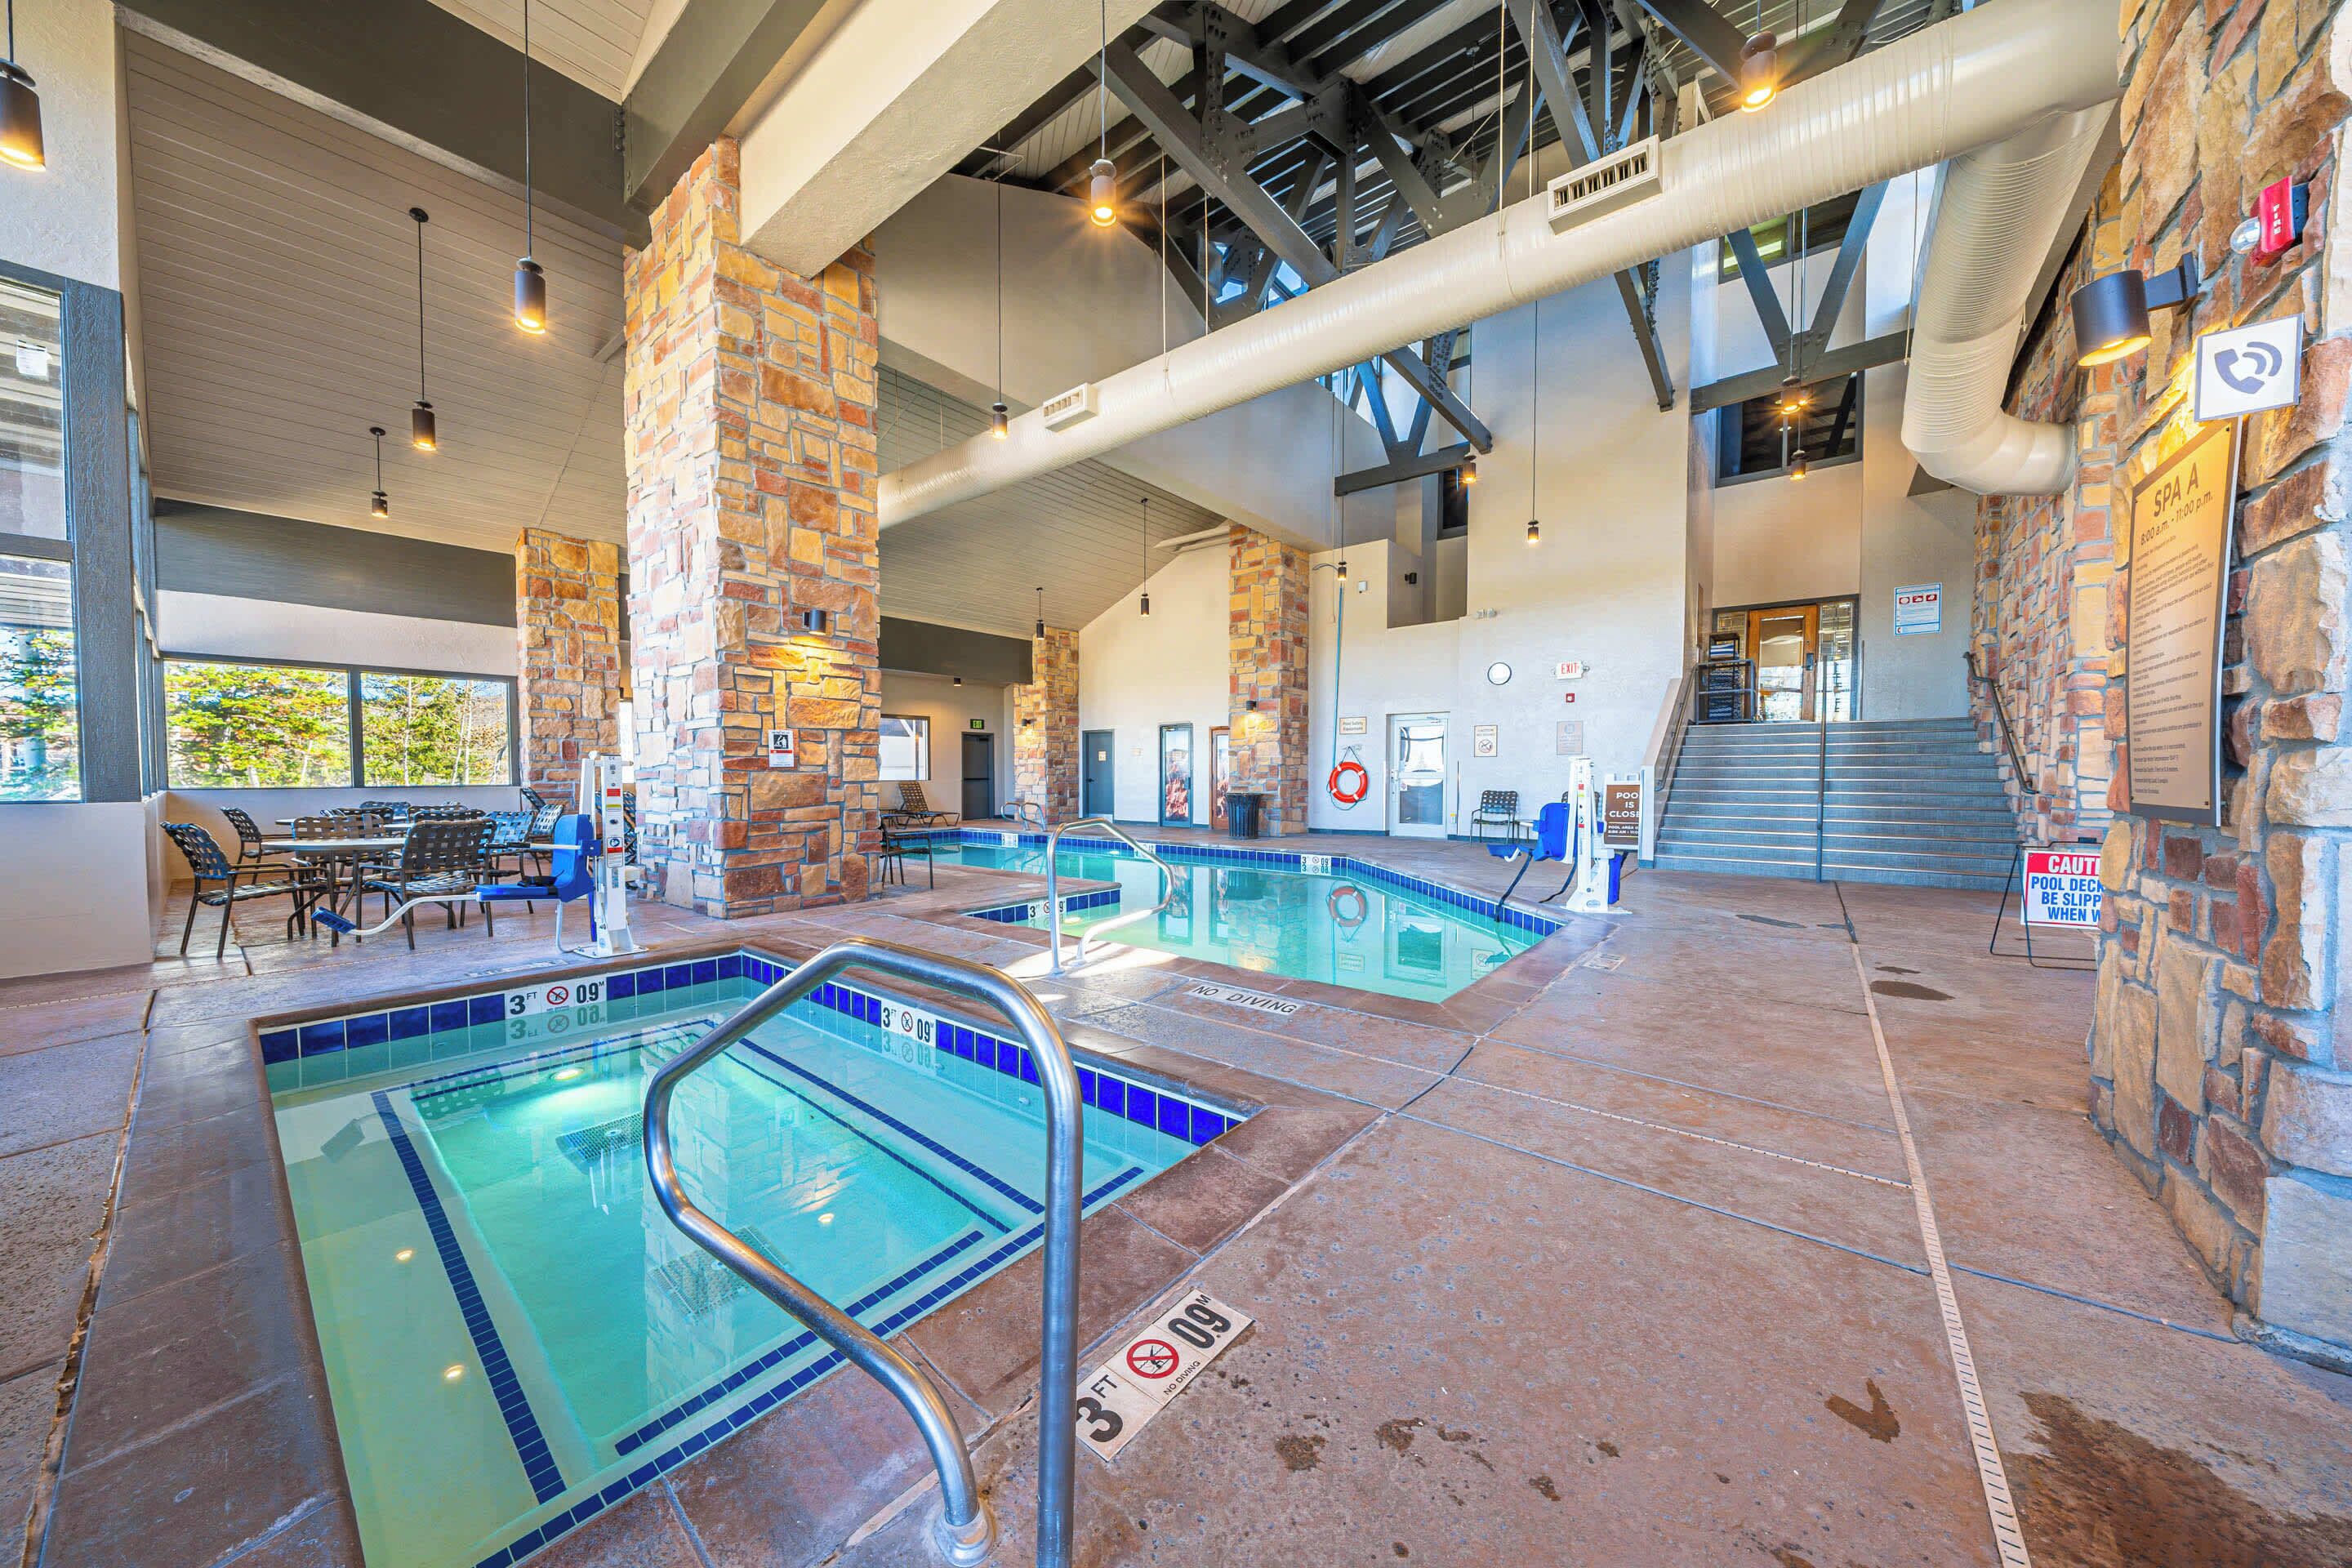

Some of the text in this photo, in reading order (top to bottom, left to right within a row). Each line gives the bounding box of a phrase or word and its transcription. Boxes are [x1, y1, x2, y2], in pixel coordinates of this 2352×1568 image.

[2154, 462, 2198, 518] SPA A
[2140, 527, 2155, 546] 8:00
[2176, 500, 2194, 523] 11:00
[2195, 491, 2213, 513] p.m.
[1561, 662, 1577, 675] EXIT
[2031, 875, 2065, 892] POOL
[2042, 891, 2058, 905] BE
[1030, 906, 1036, 918] 3
[2047, 906, 2087, 922] WHEN
[510, 995, 526, 1014] 3
[527, 991, 537, 1000] FT
[1192, 985, 1297, 1013] NO DIVING
[883, 1007, 891, 1028] 3
[1163, 1360, 1201, 1396] NO DIVING
[1076, 1374, 1124, 1443] 3 FT
